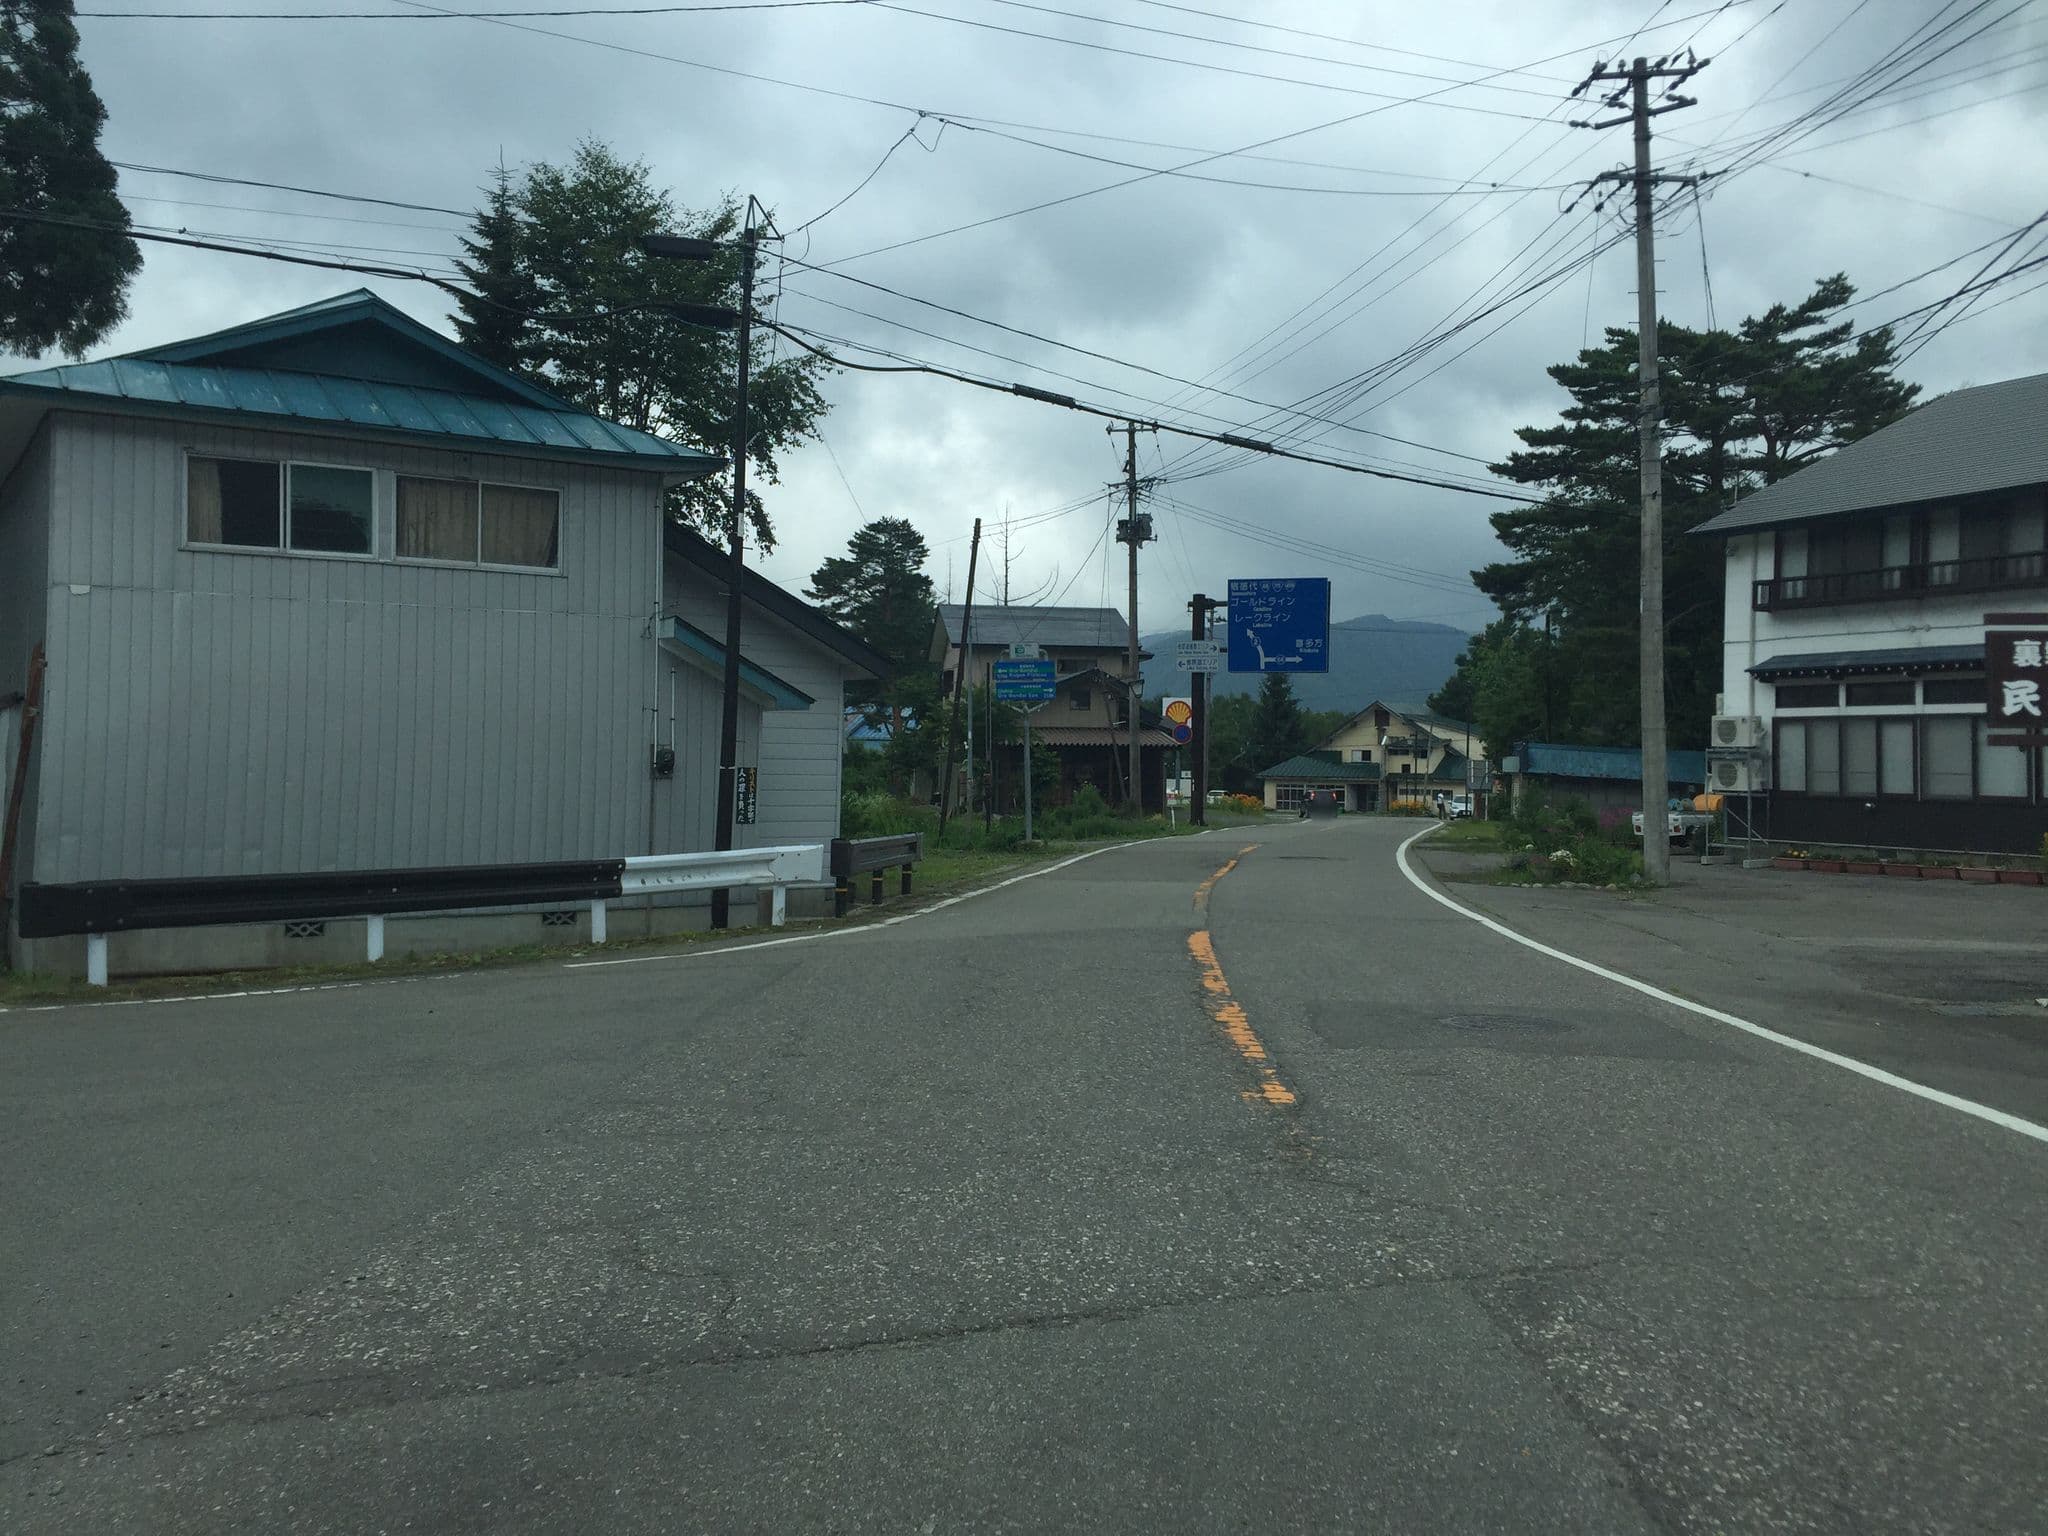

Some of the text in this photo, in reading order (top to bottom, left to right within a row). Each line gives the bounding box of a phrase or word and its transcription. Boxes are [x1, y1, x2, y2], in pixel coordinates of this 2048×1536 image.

[1231, 597, 1296, 607] ゴールドライン
[1235, 613, 1290, 623] レークライン
[2013, 639, 2048, 668] 裏
